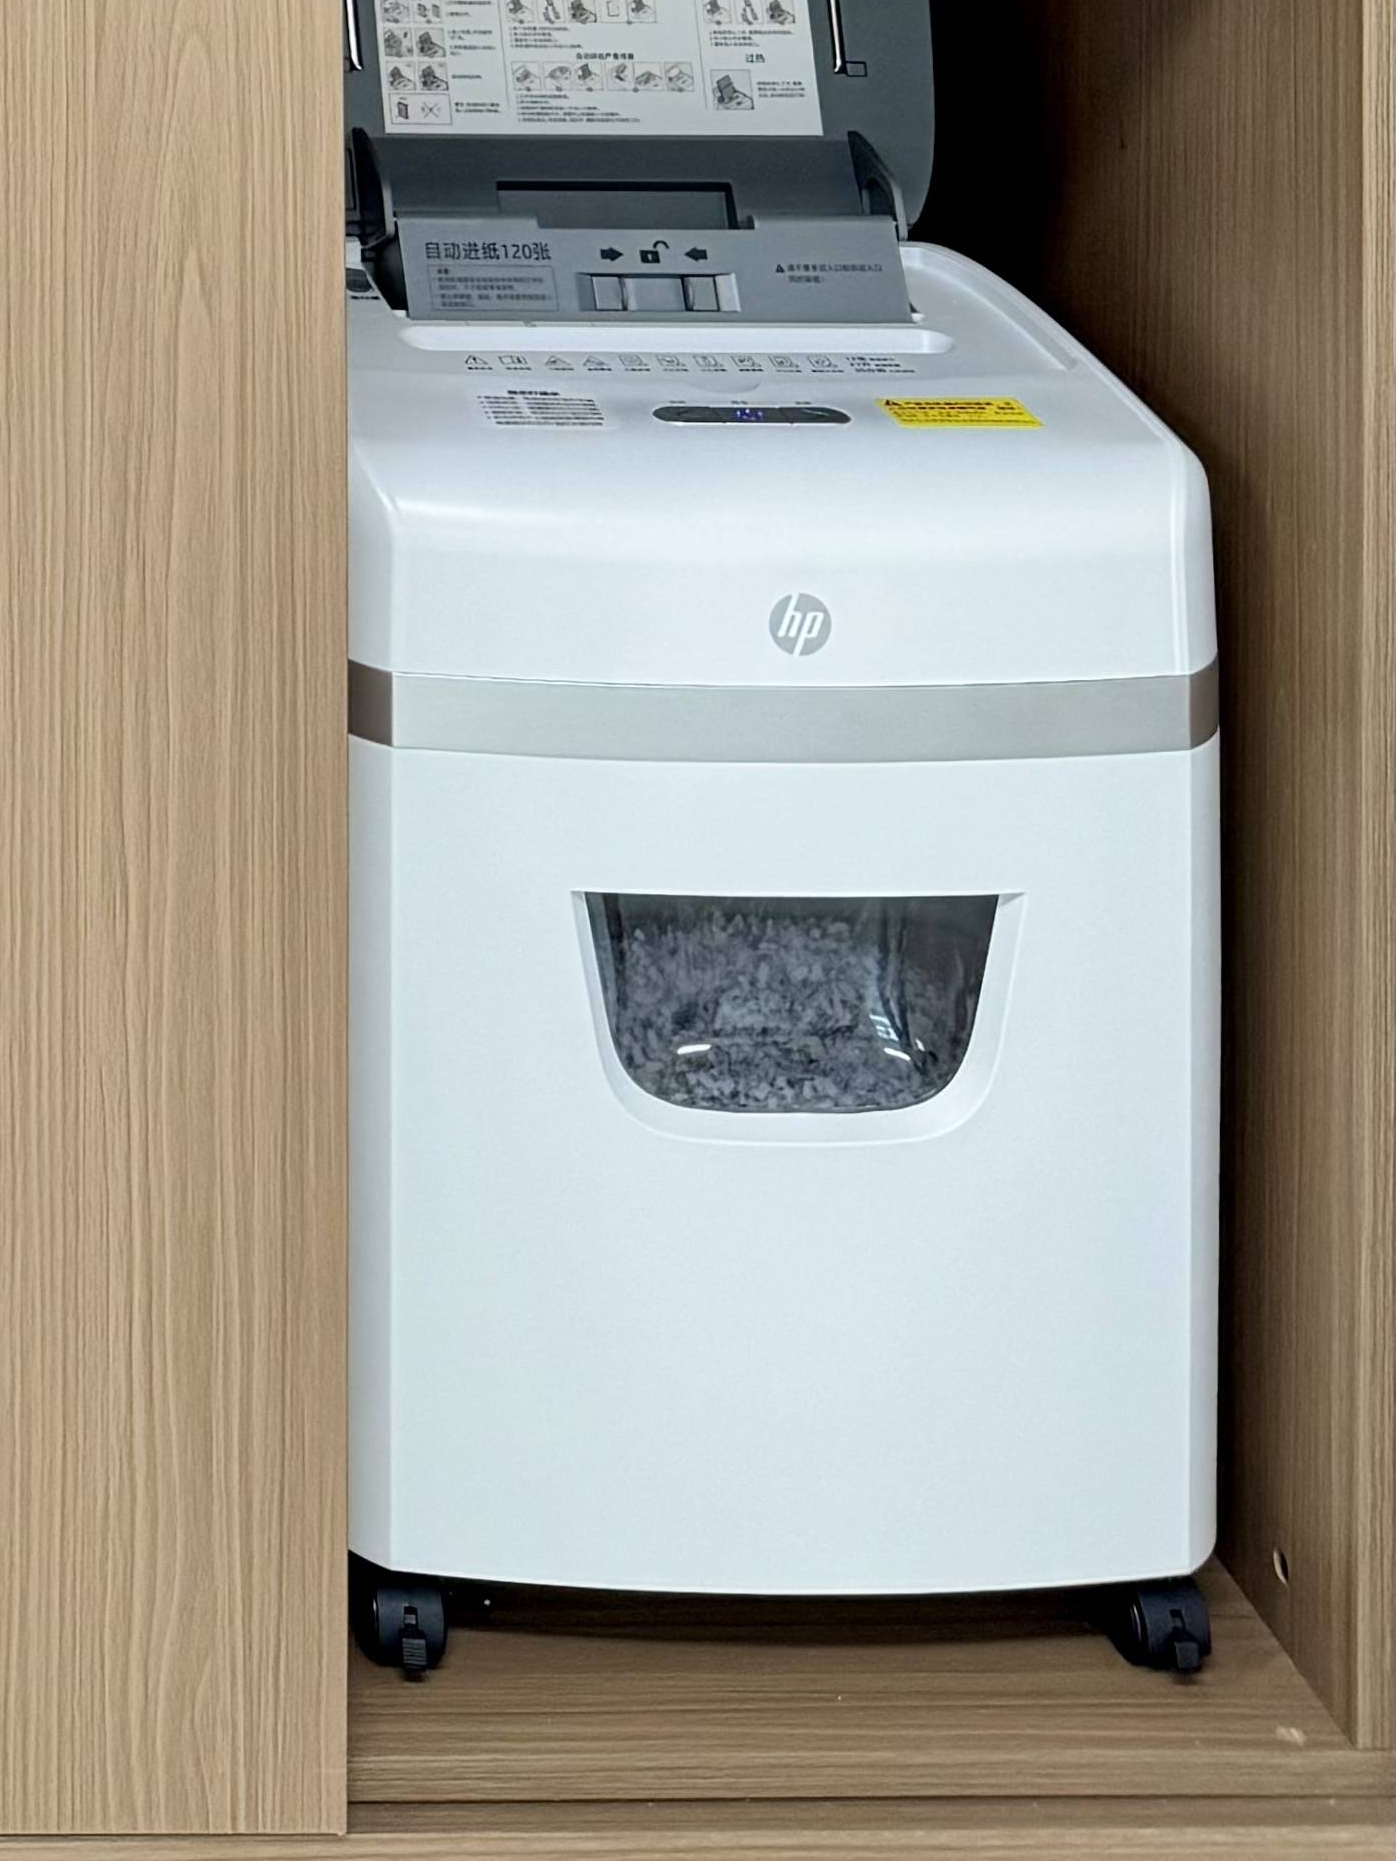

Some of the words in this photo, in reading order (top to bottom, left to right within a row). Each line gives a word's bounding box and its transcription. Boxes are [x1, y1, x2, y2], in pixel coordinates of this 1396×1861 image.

[424, 241, 552, 261] 自动进纸120张
[777, 592, 824, 656] hp
